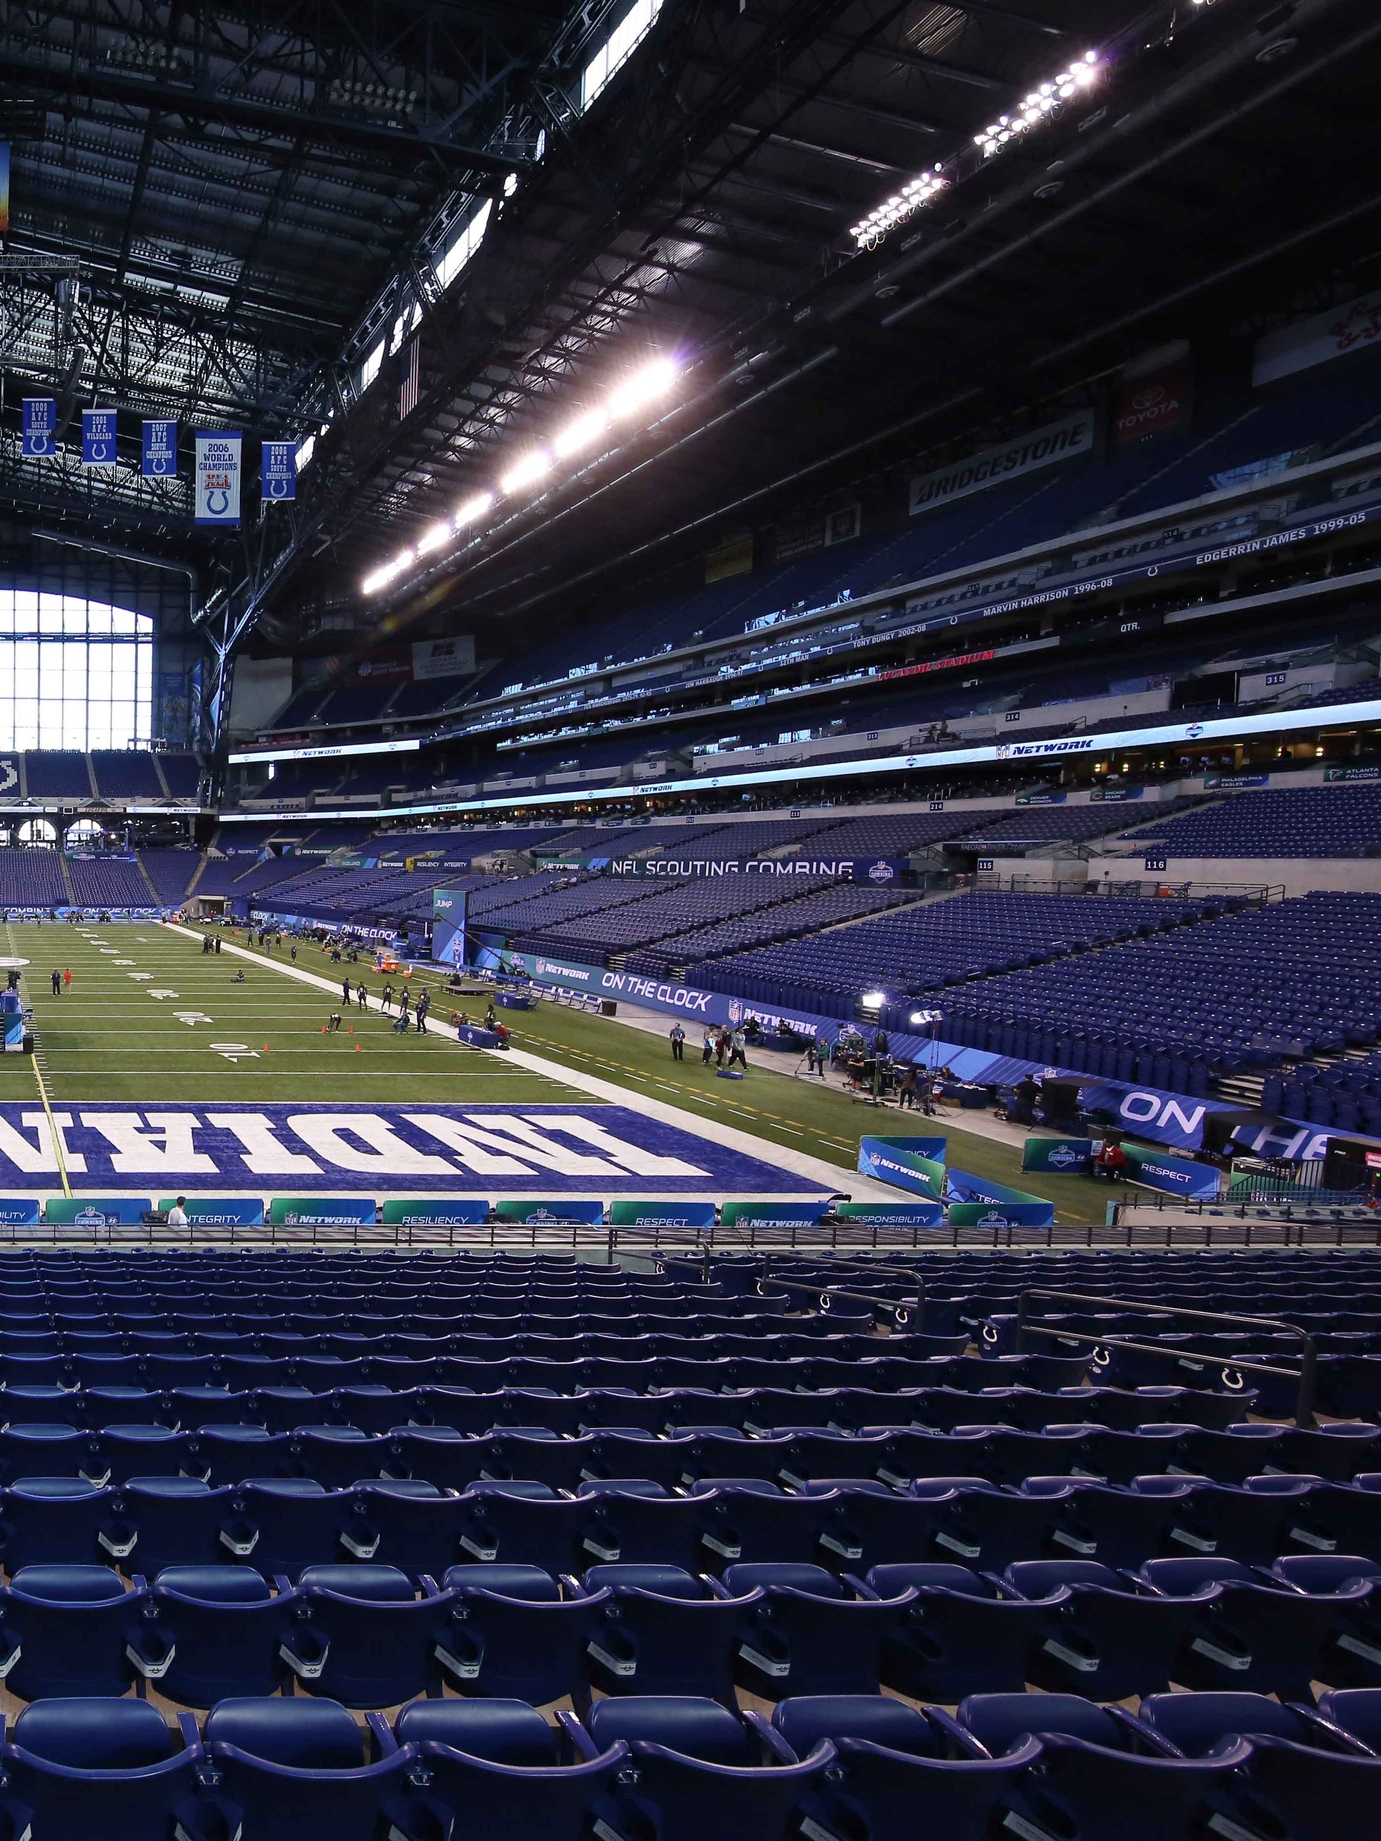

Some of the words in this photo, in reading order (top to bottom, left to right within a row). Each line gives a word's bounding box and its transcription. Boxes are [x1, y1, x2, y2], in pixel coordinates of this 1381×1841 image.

[31, 412, 47, 421] AFC
[1118, 400, 1180, 431] TOYOTA
[92, 424, 106, 432] AFC
[152, 424, 167, 432] 2007
[86, 432, 112, 440] WILDCARD
[152, 432, 166, 442] AFC
[207, 444, 229, 453] 2006
[146, 451, 172, 459] CHAMPIONS
[203, 453, 234, 462] WORLD
[271, 455, 287, 464] AFC
[199, 462, 237, 471] CHAMPIONS
[916, 421, 1088, 506] BRIDGESTONE
[265, 472, 292, 480] CHAMPIONS
[1196, 540, 1261, 565] EDGERRIN
[1263, 529, 1306, 550] JAMES
[1312, 513, 1366, 535] 1999-05
[983, 601, 1018, 617] MARVIN
[1020, 589, 1069, 608] HARRISON
[1074, 578, 1114, 596] 1996-08
[1120, 622, 1141, 633] QTR.
[852, 638, 869, 649] TONY
[871, 633, 895, 645] DUNGY
[898, 624, 927, 638] 2002-08
[779, 659, 794, 667] 12TH
[795, 655, 809, 664] MAN
[878, 667, 910, 681] LUCAS
[910, 662, 932, 674] OIL
[935, 650, 995, 670] STADIUM
[1266, 674, 1285, 684] 315
[1006, 713, 1019, 721] 314
[1012, 738, 1093, 756] NETWORK
[302, 748, 342, 757] NETWORK
[640, 784, 673, 793] NETWORK
[612, 861, 639, 875] NFL
[646, 860, 740, 877] SCOUTING
[746, 861, 854, 878] COMBINE
[979, 861, 992, 869] 115
[1147, 860, 1164, 869] 116
[435, 900, 452, 908] JUMP
[341, 924, 353, 934] ON
[354, 926, 369, 937] THE
[370, 928, 398, 940] CLOCK
[545, 964, 590, 980] NETWORK
[602, 973, 623, 990] ON
[627, 976, 655, 998] THE
[657, 985, 712, 1012] CLOCK
[744, 1008, 818, 1036] NETWORK
[208, 1043, 261, 1058] 10
[1119, 1091, 1207, 1134] ON
[880, 1158, 931, 1183] NETWORK
[1141, 1163, 1192, 1183] RESPECT
[300, 1215, 362, 1225] NETWORK
[402, 1216, 469, 1225] RESILIENCY
[635, 1217, 689, 1226] RESPECT
[750, 1218, 814, 1227] NETWORK
